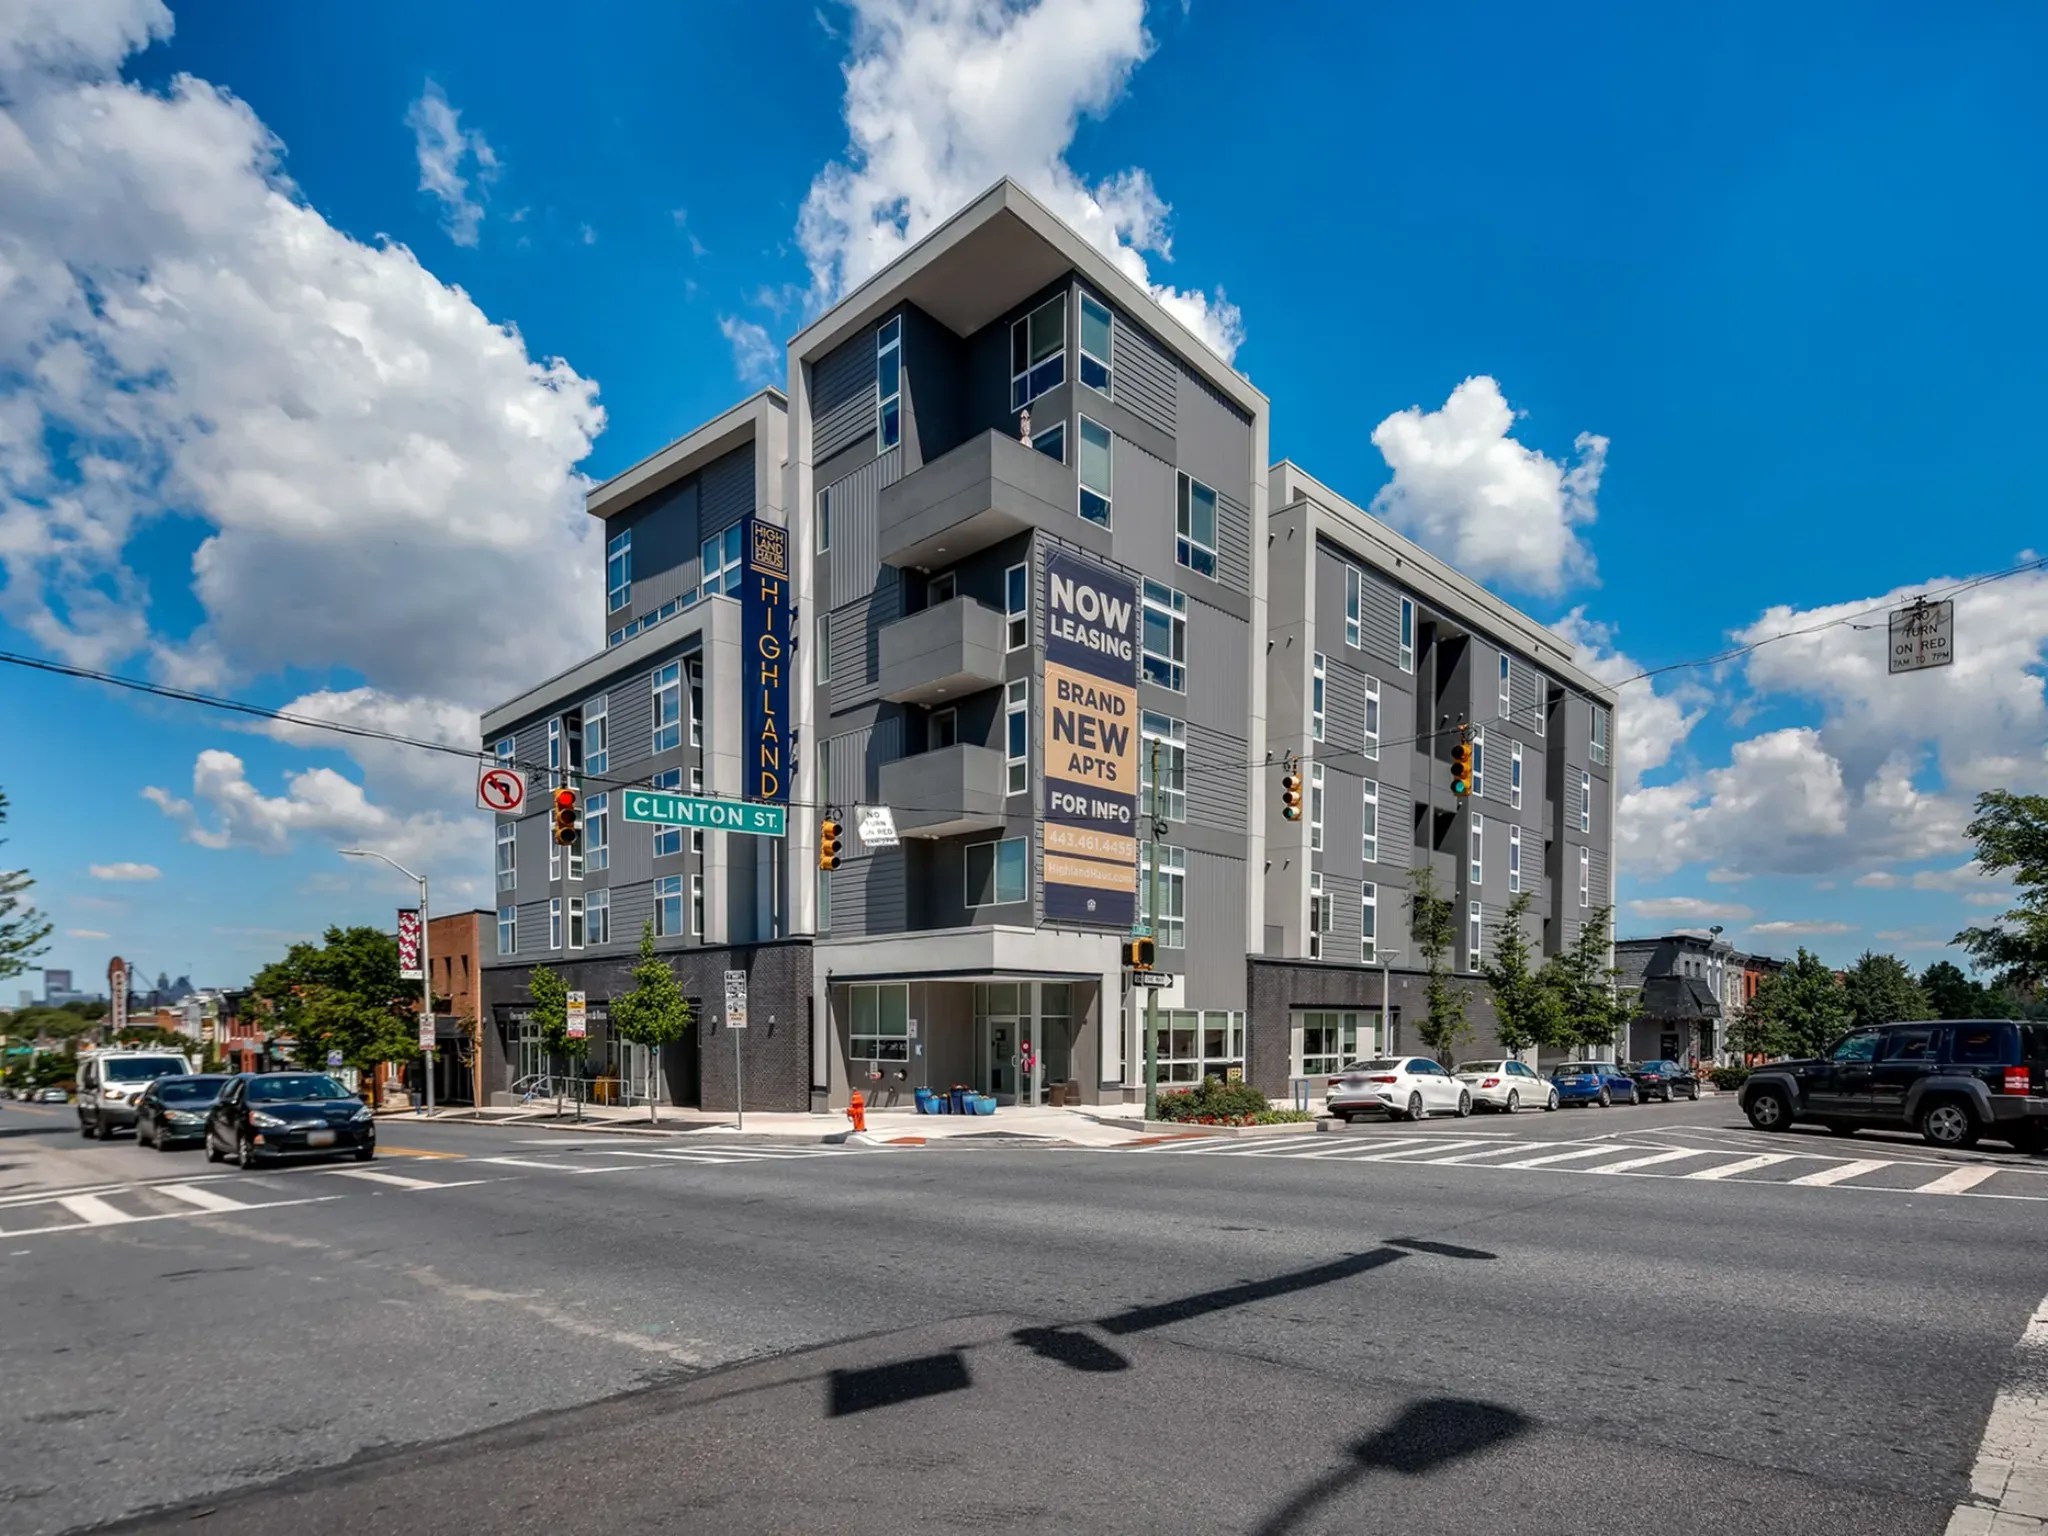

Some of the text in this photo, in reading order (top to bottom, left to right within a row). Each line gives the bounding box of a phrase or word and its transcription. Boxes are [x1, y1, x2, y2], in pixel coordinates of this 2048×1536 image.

[755, 524, 784, 544] HIGH
[755, 536, 784, 555] LAND
[1051, 573, 1132, 634] NOW
[1051, 614, 1133, 661] LEASING
[1895, 637, 1946, 655] ON RED
[1915, 655, 1926, 664] TO
[1932, 651, 1949, 660] 7PM
[758, 577, 781, 799] HIGHLAND
[1057, 678, 1126, 717] BRAND
[1053, 706, 1129, 757] NEW
[1068, 752, 1117, 782] APTS
[633, 796, 778, 829] CLINTON ST.
[1051, 791, 1131, 824] FOR INFO
[877, 828, 893, 836] RED
[1050, 830, 1133, 857] 443.461.4455
